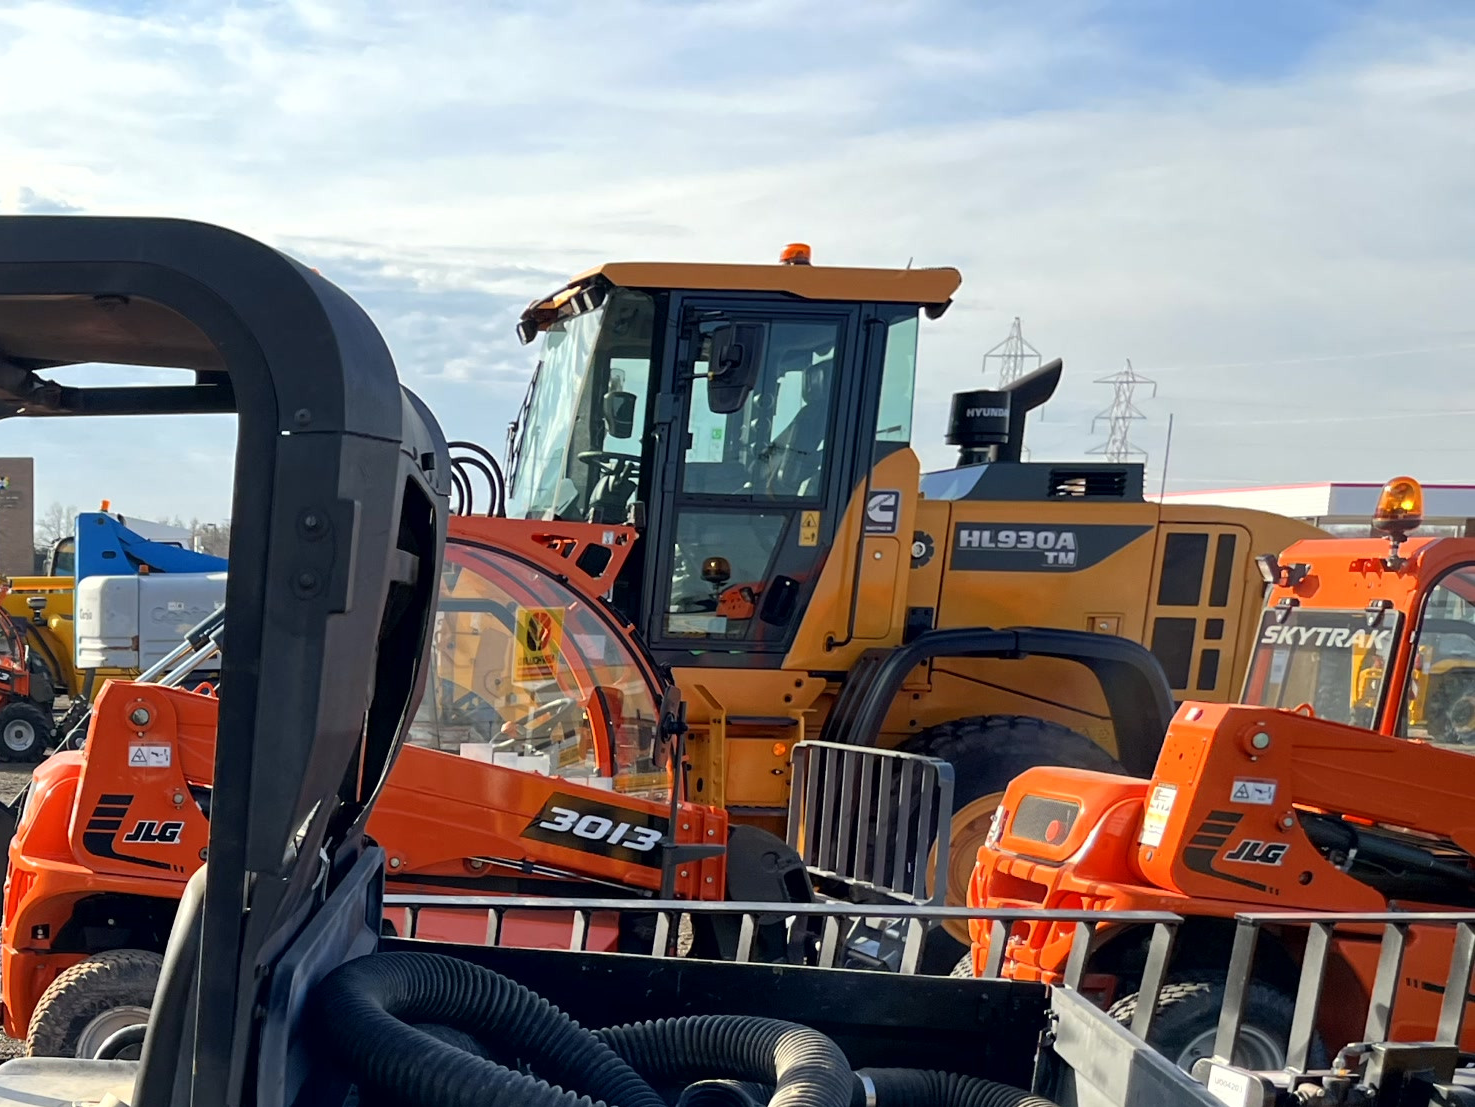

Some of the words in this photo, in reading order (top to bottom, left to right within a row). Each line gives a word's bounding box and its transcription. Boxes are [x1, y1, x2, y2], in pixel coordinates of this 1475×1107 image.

[958, 529, 1076, 550] HL930A
[1044, 551, 1076, 565] TM
[1261, 625, 1392, 650] SKYTRAK
[122, 820, 185, 844] JLG
[539, 806, 663, 851] 3013
[1223, 839, 1290, 866] JLG
